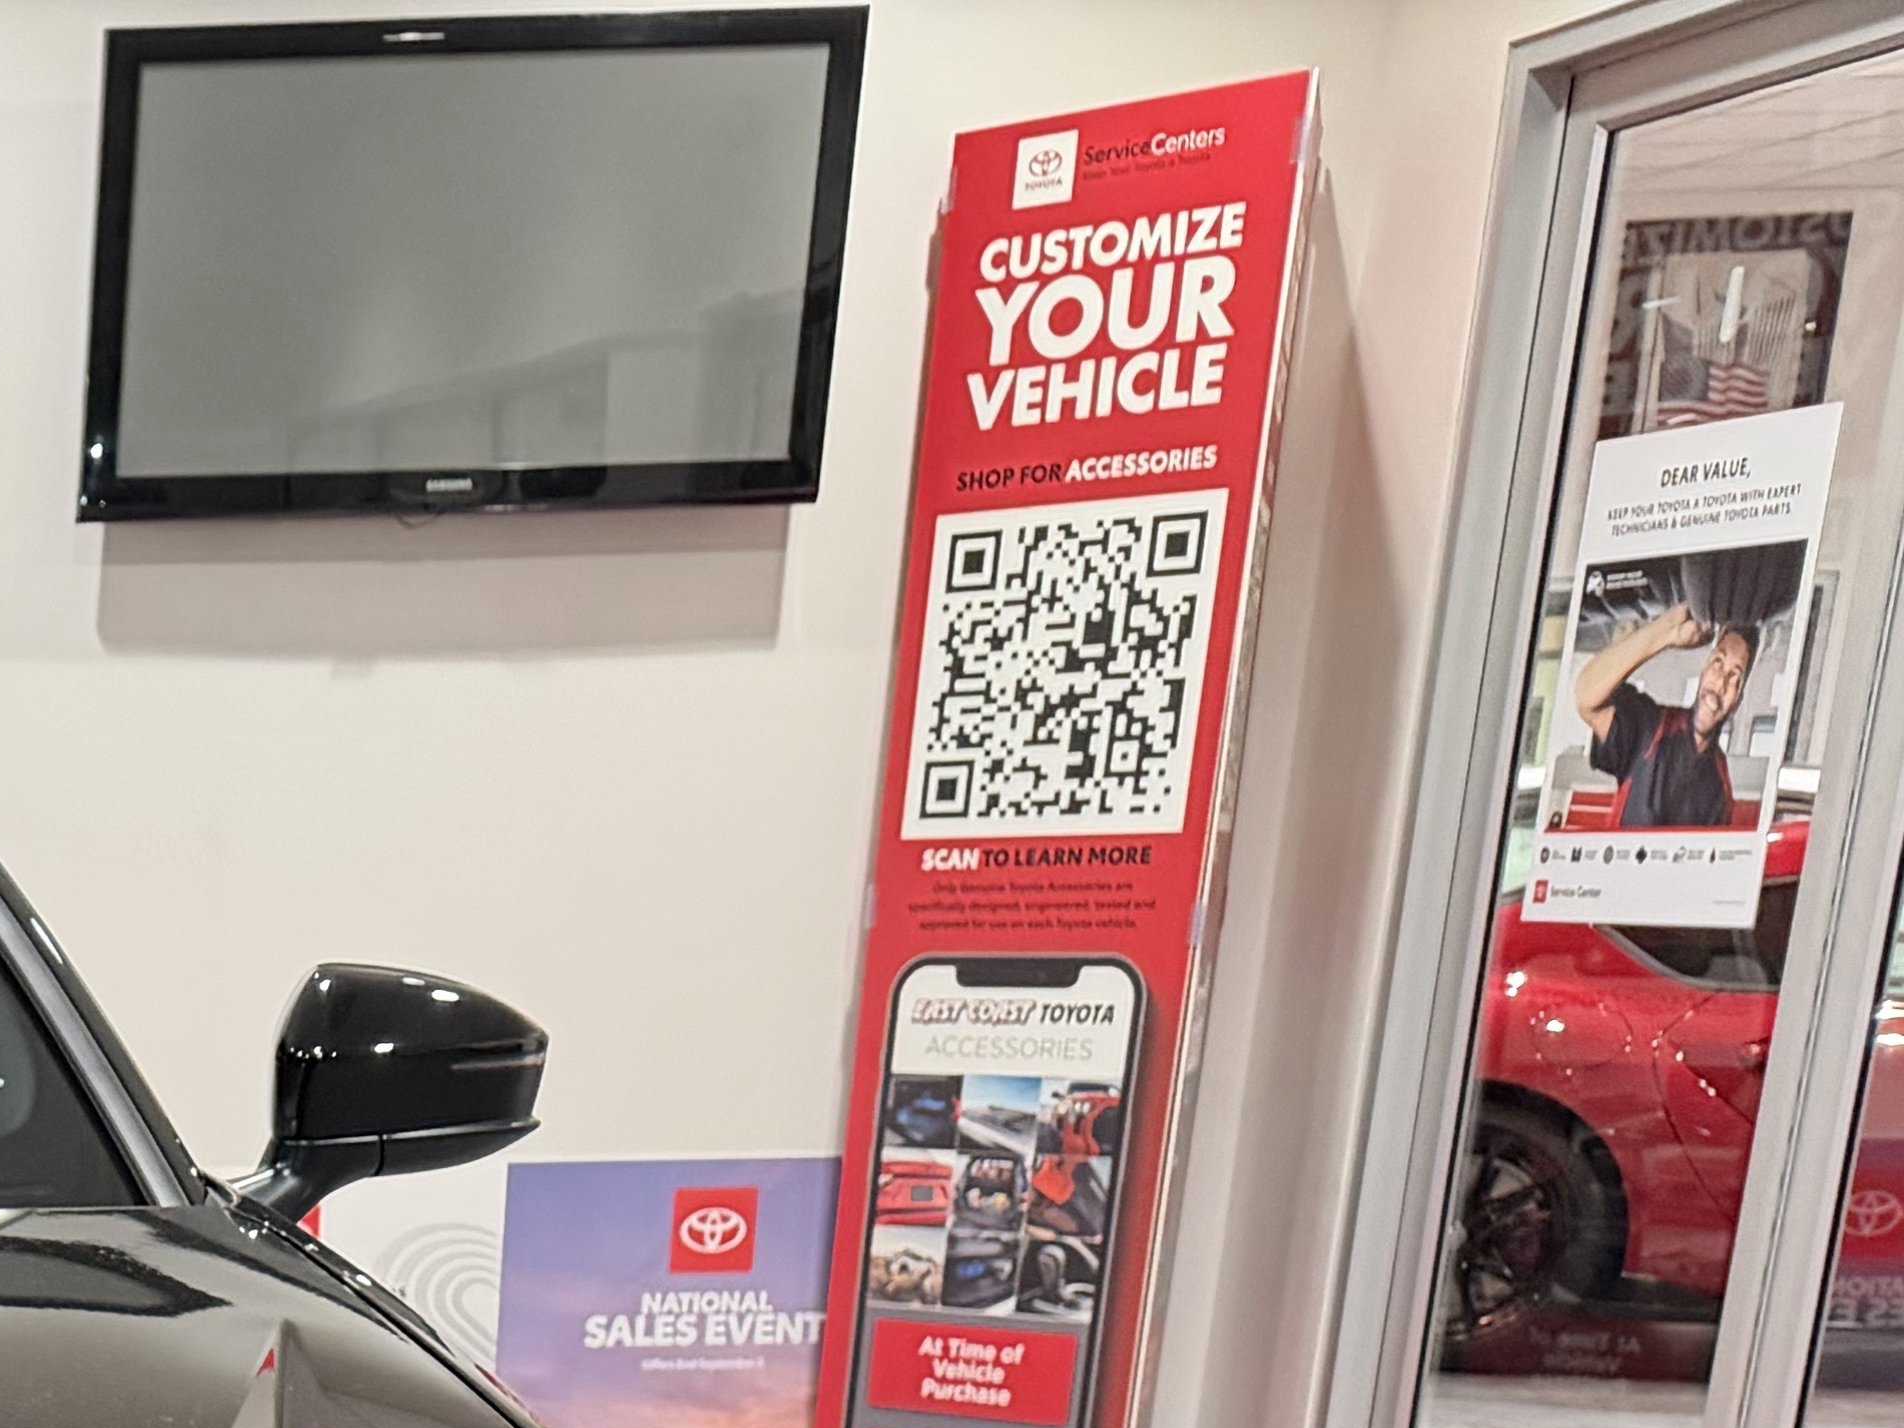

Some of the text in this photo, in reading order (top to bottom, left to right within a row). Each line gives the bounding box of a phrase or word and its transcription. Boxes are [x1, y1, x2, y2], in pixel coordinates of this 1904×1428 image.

[979, 200, 1247, 283] CUSTOMIZE
[975, 254, 1236, 367] YOUR
[966, 342, 1228, 432] VEHICLE
[956, 444, 1218, 492] SHOP FOR ACCESSORIES
[1661, 457, 1752, 488] DEAR VALUE,
[1657, 500, 1691, 516] TOYOTA
[1702, 492, 1737, 508] TOYOTA
[921, 846, 1152, 871] SCAN TO LEARN MORE
[1040, 1003, 1116, 1025] TOYOTA
[924, 1035, 1094, 1060] ACCESSORIES
[641, 1290, 773, 1315] NATIONAL
[584, 1311, 826, 1349] SALES EVENT
[918, 1336, 1025, 1364] At Time of
[933, 1361, 1005, 1383] Vehicle
[921, 1379, 1011, 1407] Purchase
